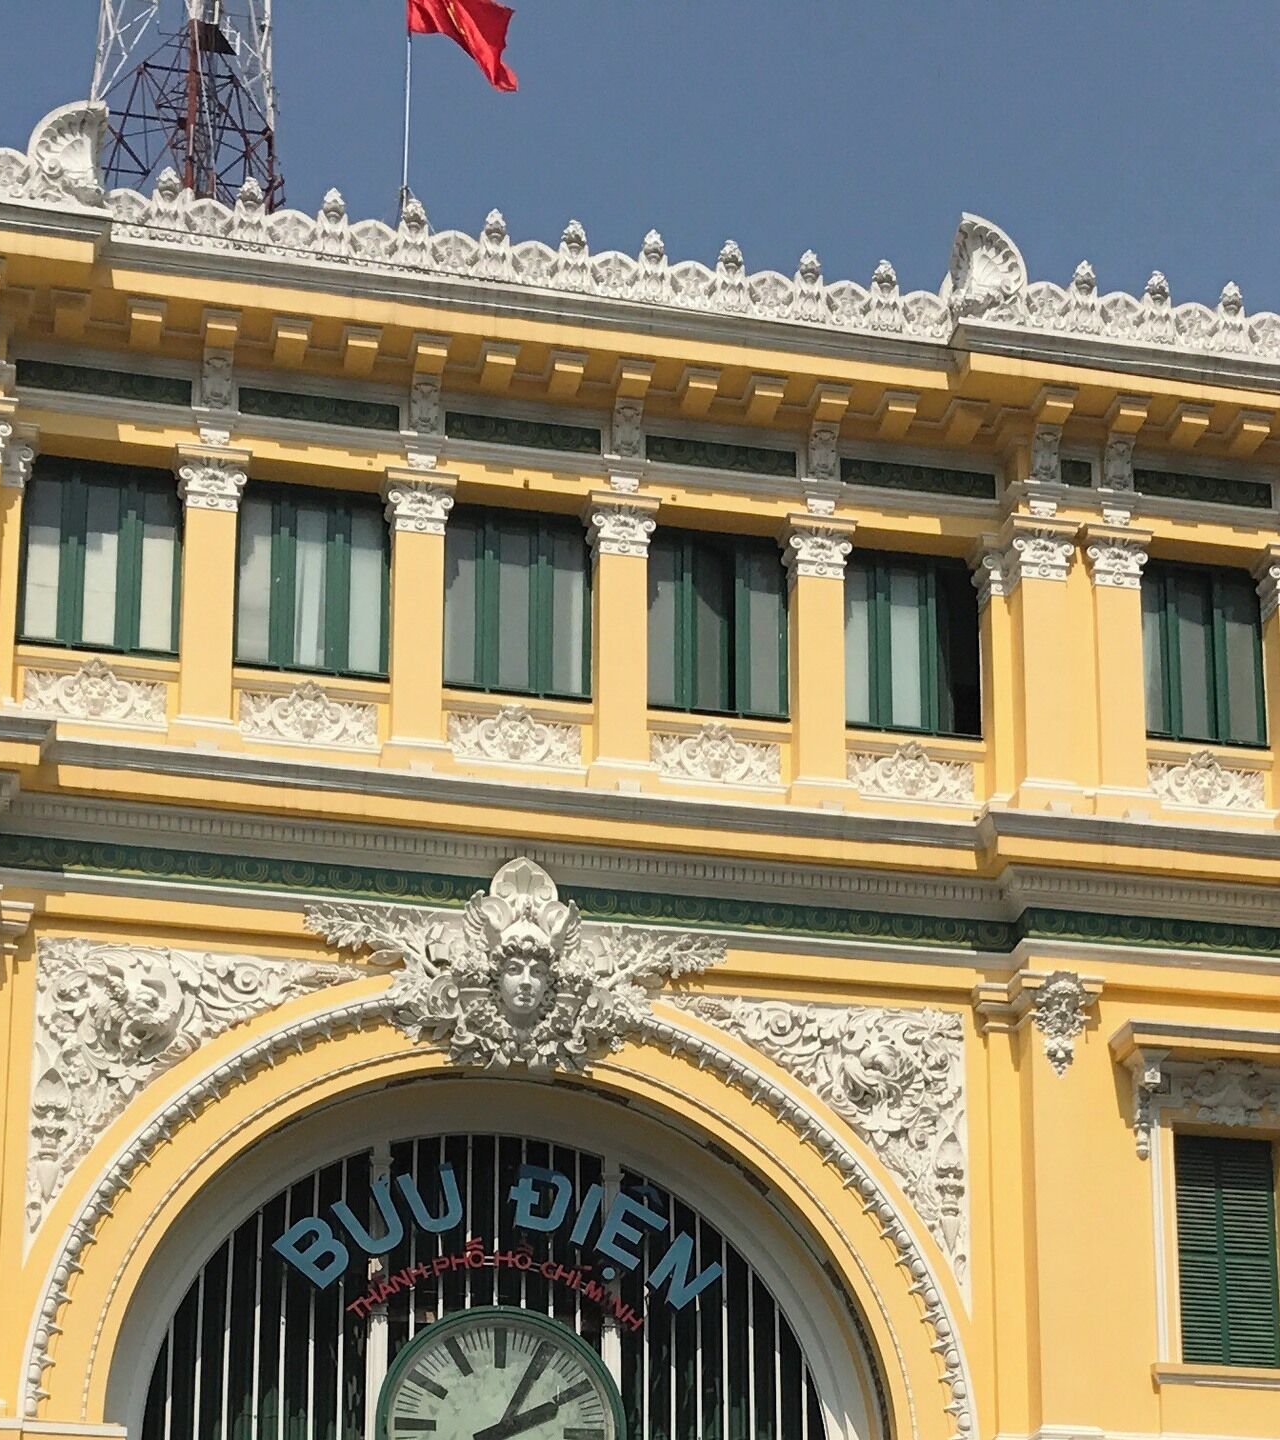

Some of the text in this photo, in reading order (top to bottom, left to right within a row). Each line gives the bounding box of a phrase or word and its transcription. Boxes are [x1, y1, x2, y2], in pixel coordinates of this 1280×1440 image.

[271, 1161, 724, 1311] BƯU ĐIỆN
[431, 1236, 485, 1277] PHỐ
